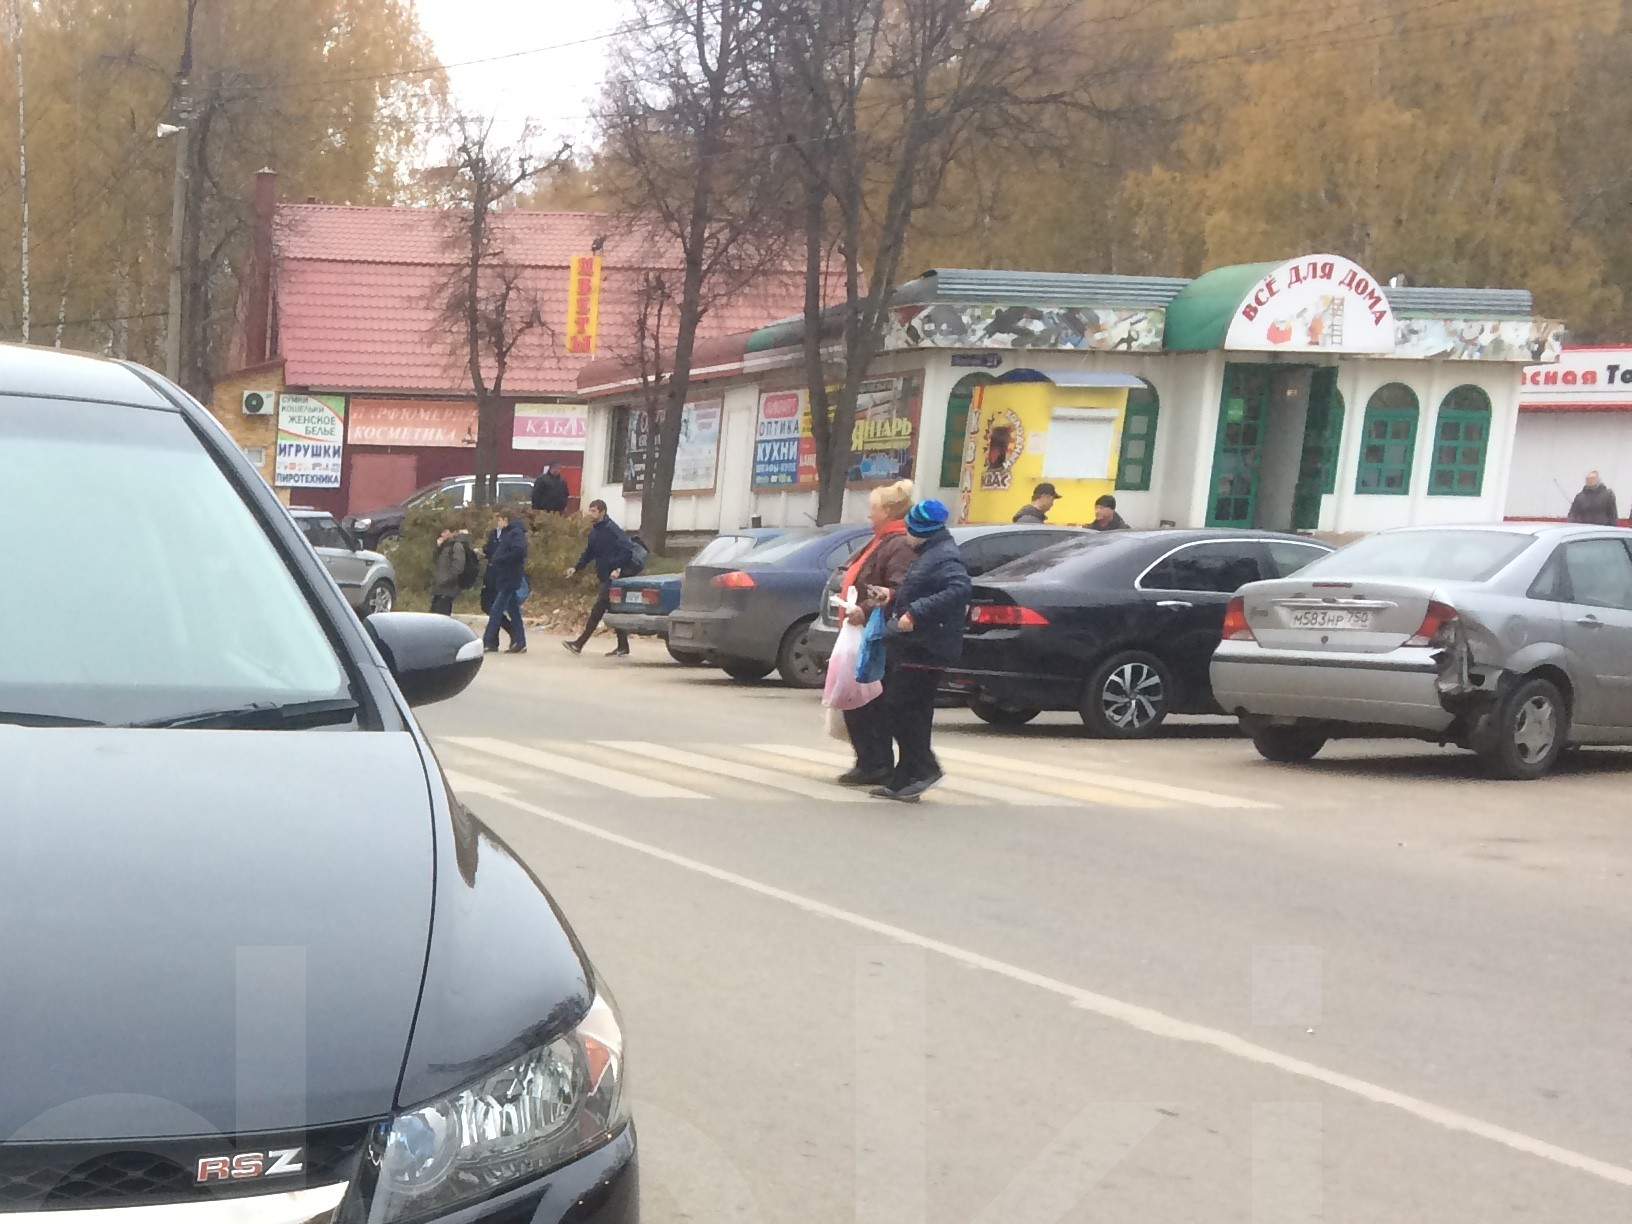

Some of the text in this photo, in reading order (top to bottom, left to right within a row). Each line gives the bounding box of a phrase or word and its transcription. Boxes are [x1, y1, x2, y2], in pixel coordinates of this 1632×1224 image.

[1241, 261, 1387, 326] ВСЁ ДЛЯ ДОМА
[570, 257, 594, 353] ЦВЕТЫ
[281, 405, 325, 413] КОШЕЛЬКИ
[287, 415, 337, 426] ЖЕНСКОЕ
[758, 419, 800, 437] ОПТИКА
[304, 426, 336, 437] БЕЛЬЕ
[353, 425, 457, 441] КОСМЕТИКА
[851, 417, 913, 452] ЯНТАРЬ
[278, 443, 342, 458] ИГРУШКИ
[756, 441, 798, 462] КУХНИ
[275, 472, 340, 485] ПИРОТЕХНИКА
[195, 1145, 305, 1184] RSZ
